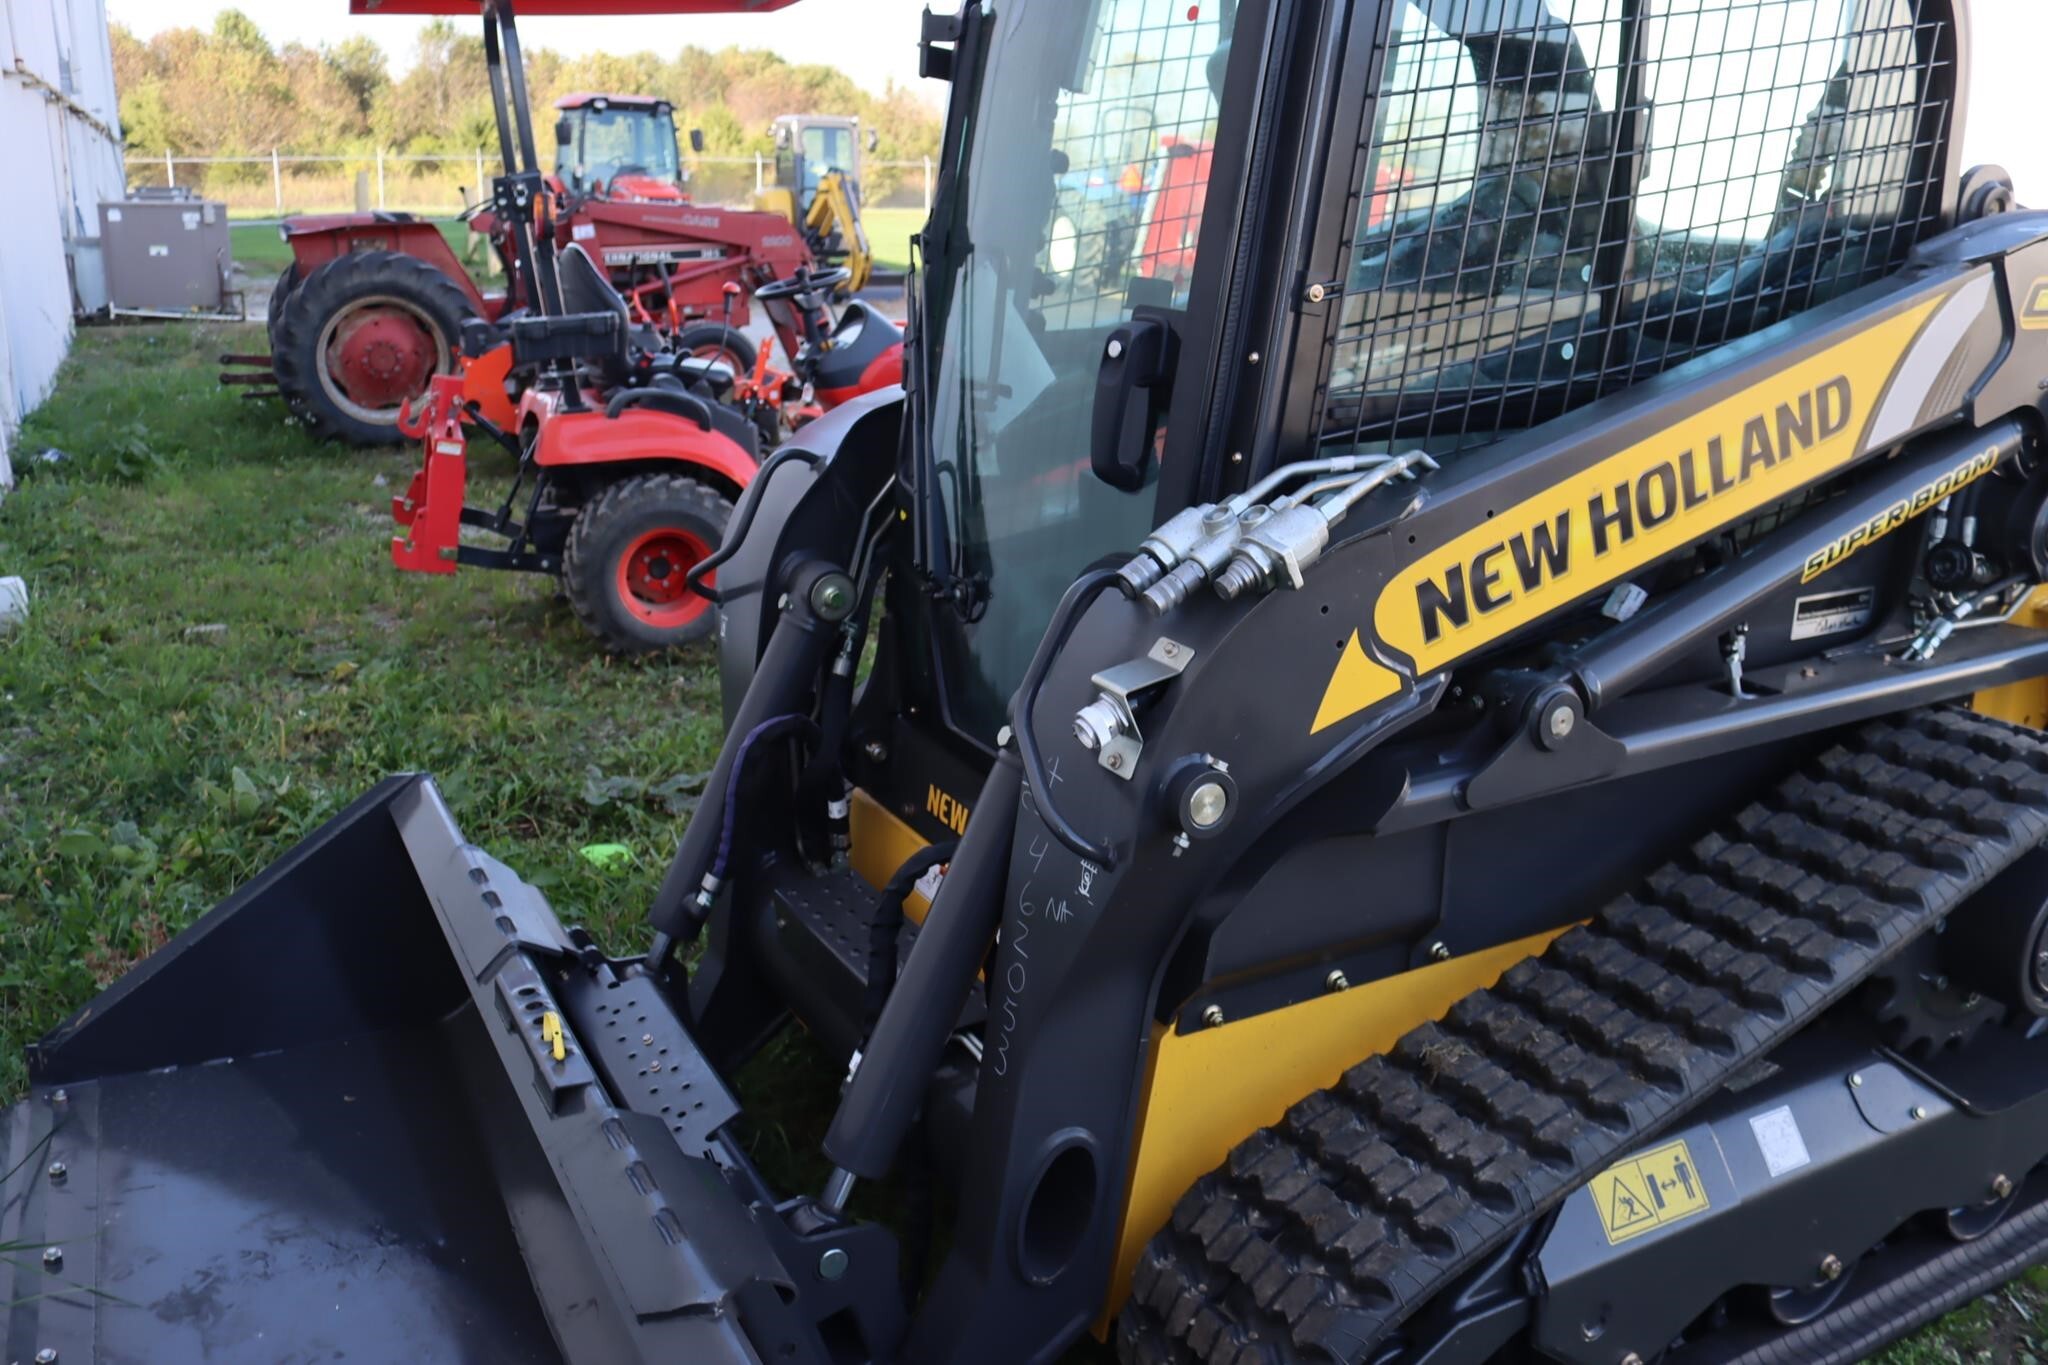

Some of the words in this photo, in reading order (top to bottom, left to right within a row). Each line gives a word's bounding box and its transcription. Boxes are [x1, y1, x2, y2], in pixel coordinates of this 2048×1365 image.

[1415, 508, 1571, 645] NEW
[1587, 373, 1853, 559] HOLLAND
[1800, 499, 1911, 584] SUPER
[1909, 446, 1999, 519] BOOM
[926, 783, 969, 836] NEW
